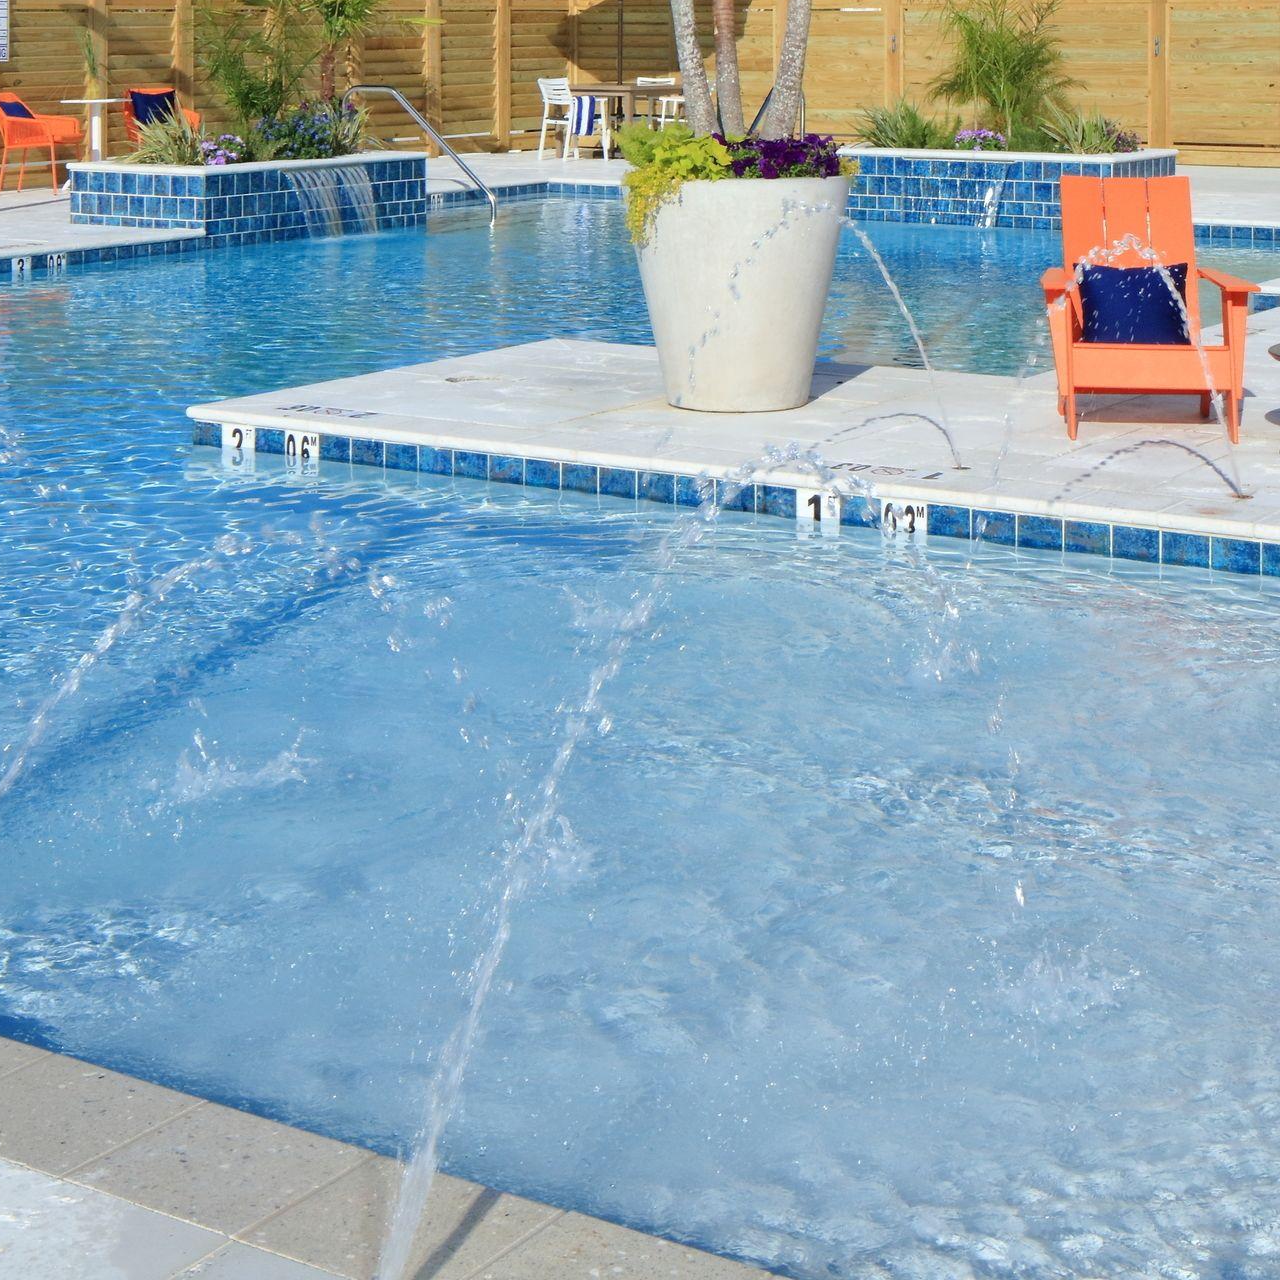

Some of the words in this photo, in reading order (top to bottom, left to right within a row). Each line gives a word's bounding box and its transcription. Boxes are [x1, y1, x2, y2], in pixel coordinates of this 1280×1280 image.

[310, 436, 317, 447] M
[807, 494, 821, 521] 1
[916, 505, 925, 518] M
